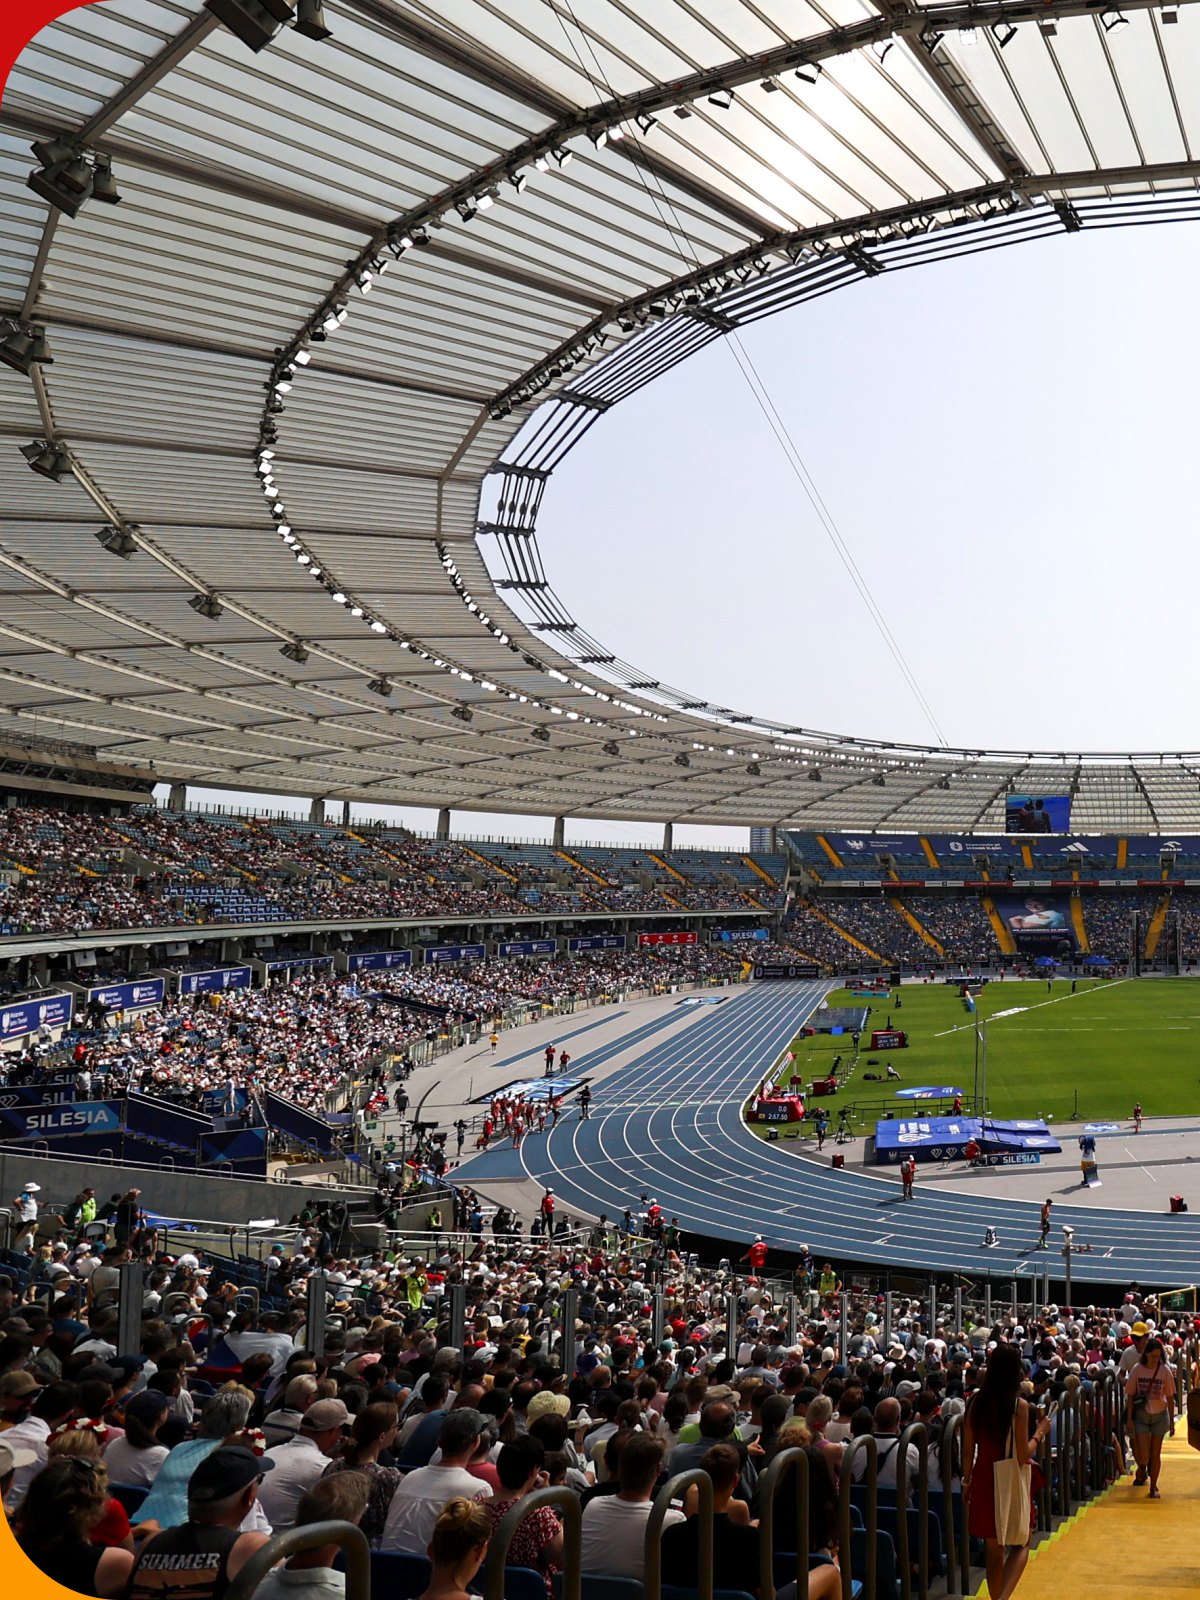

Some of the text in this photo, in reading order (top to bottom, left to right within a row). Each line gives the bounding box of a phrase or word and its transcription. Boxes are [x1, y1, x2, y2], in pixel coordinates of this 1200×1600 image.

[731, 931, 757, 940] SILESIA
[26, 1110, 109, 1130] SILESIA
[1002, 1154, 1037, 1164] SILESIA
[138, 1552, 220, 1571] SUMMER
